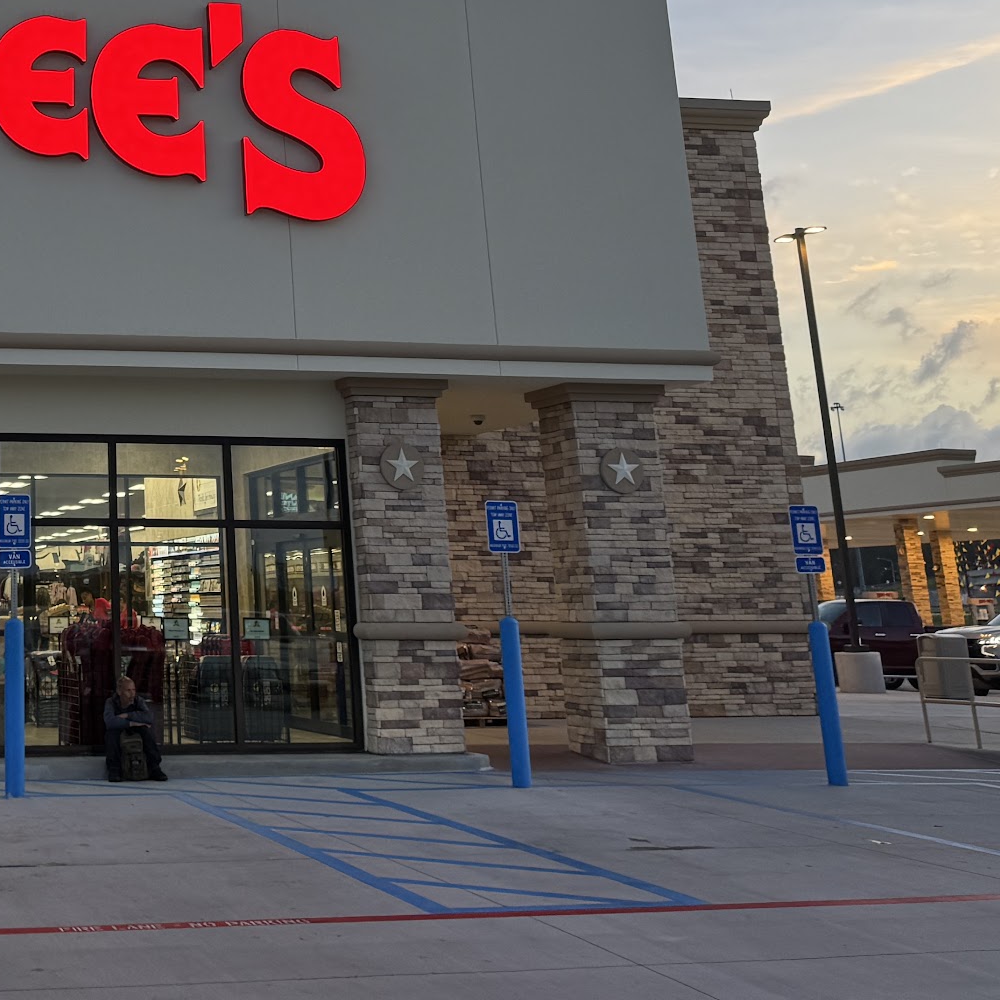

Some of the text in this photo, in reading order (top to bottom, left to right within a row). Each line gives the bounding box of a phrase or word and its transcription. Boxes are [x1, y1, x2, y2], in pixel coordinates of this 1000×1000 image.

[58, 918, 312, 933] FIRE LANE NO PARKING
